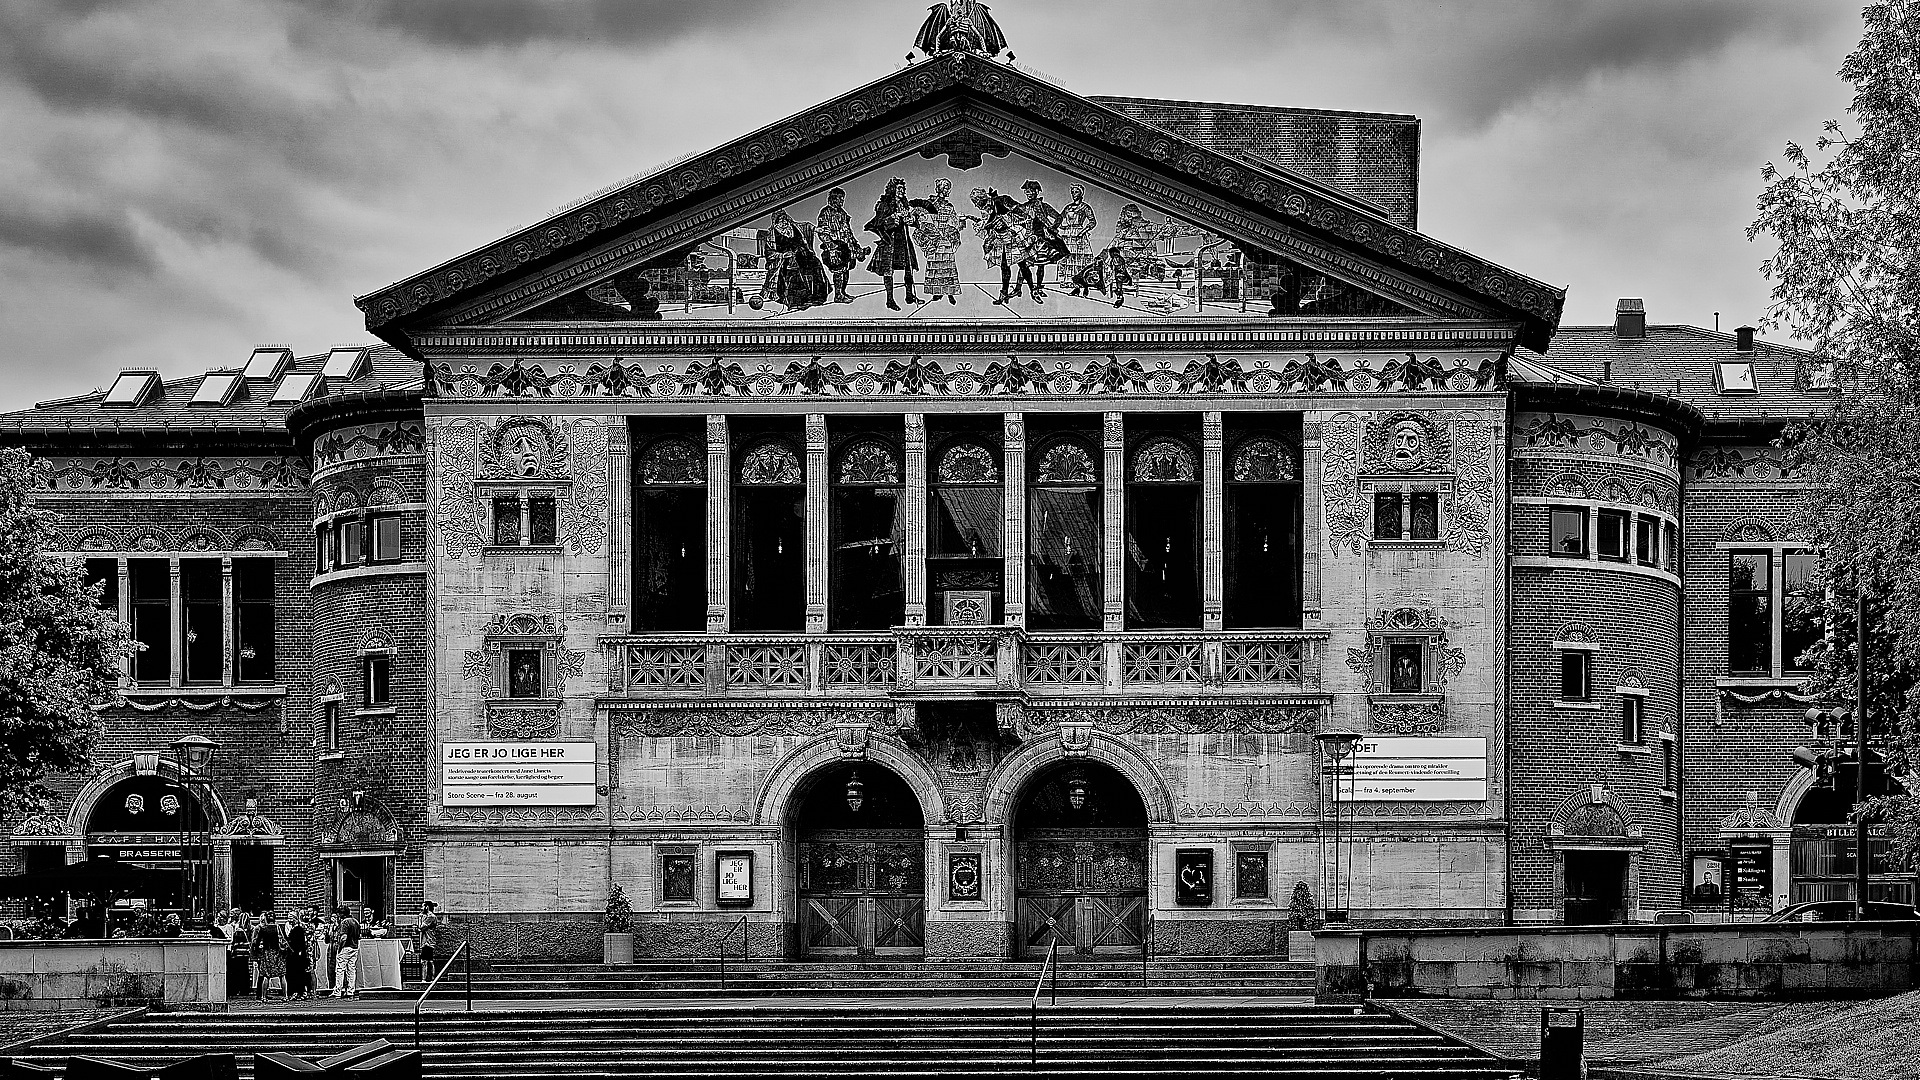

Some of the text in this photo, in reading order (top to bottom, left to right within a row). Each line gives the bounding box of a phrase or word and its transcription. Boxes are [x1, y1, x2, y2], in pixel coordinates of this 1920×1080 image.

[447, 748, 565, 759] JEG ER JO LIGE HER
[1363, 786, 1373, 794] fra
[1373, 786, 1381, 794] 4.
[1381, 786, 1416, 795] september
[447, 791, 465, 799] Store
[466, 791, 485, 799] Scene
[495, 791, 504, 799] fra
[516, 791, 538, 800] august
[1826, 828, 1885, 837] BILLEALG
[119, 850, 182, 858] BRASSERIE
